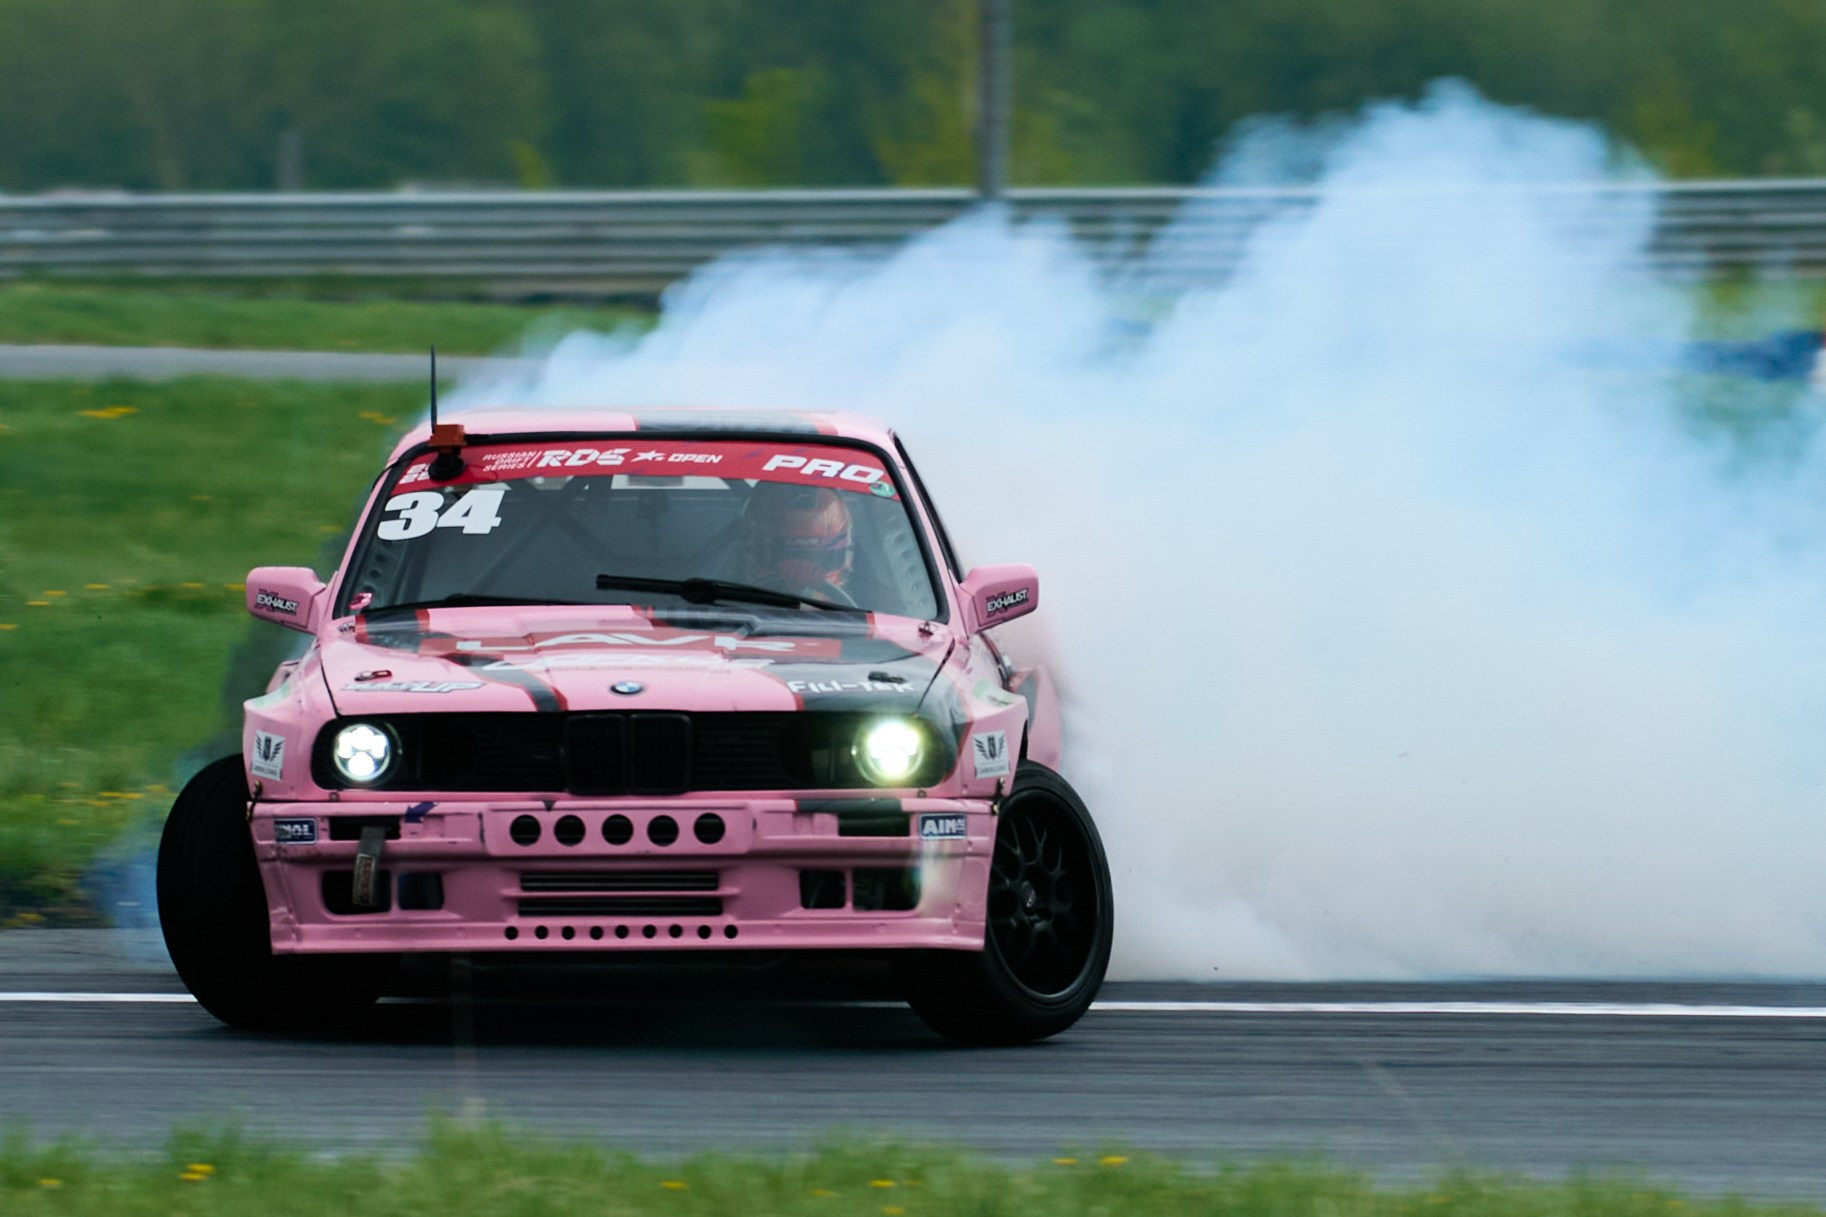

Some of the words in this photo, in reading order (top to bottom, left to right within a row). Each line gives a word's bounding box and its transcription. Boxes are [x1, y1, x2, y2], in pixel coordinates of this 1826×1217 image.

[537, 448, 631, 468] RDS
[667, 453, 723, 464] OPEN
[762, 454, 885, 484] PRO
[377, 489, 505, 541] 34
[256, 594, 299, 612] EXHAUST
[987, 588, 1028, 612] EXHAUST
